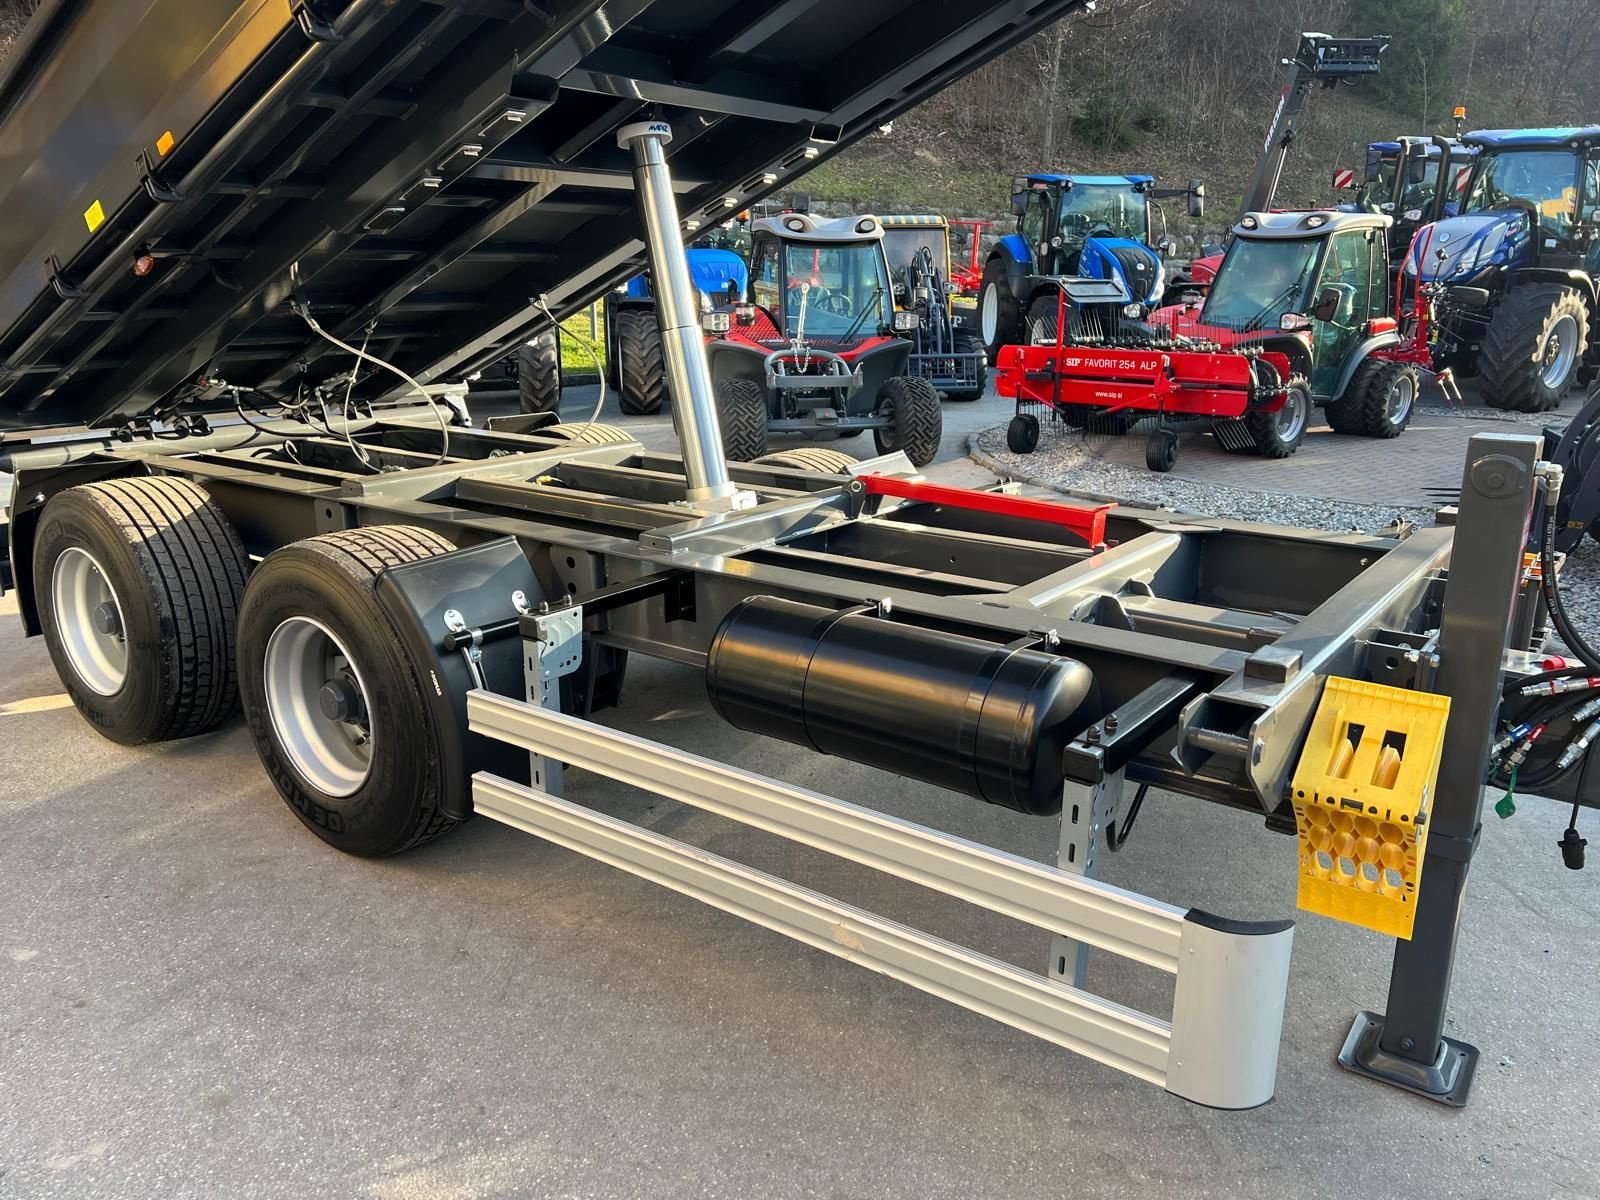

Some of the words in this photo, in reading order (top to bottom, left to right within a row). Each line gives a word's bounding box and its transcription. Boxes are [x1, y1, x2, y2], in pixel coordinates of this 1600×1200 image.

[1084, 358, 1117, 369] FAVORIT
[1119, 359, 1136, 369] 254
[1140, 361, 1157, 370] ALP
